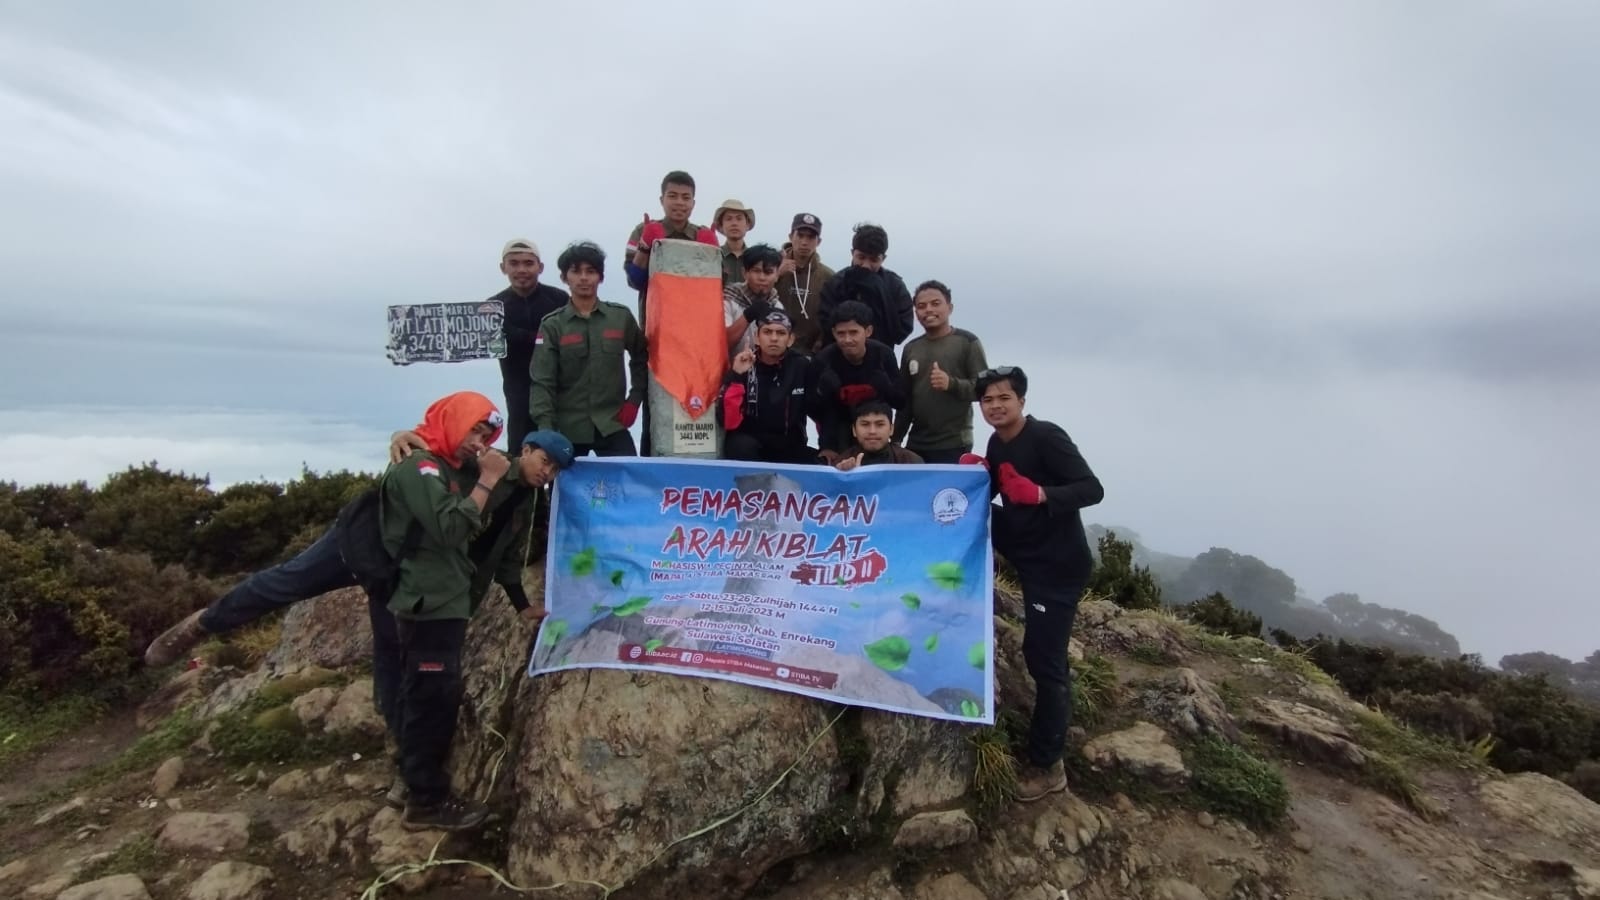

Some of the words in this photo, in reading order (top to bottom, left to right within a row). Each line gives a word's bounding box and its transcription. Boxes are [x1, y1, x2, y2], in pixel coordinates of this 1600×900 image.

[446, 304, 475, 315] MARIO
[415, 315, 500, 334] LATIMOJONG
[409, 333, 443, 352] 3478
[449, 332, 485, 350] MDPL
[675, 423, 694, 431] RANTE
[696, 423, 714, 431] MARIO
[680, 432, 693, 440] 3443
[695, 432, 710, 440] MDPL
[661, 487, 878, 526] PEMASANGAN
[662, 525, 753, 560] ARAH
[755, 530, 869, 561] KIBLAT
[756, 560, 784, 571] ALAM
[861, 559, 872, 578] II
[701, 603, 724, 612] 12-15
[727, 604, 746, 615] Juli
[747, 607, 773, 617] 2023
[775, 611, 785, 619] M
[722, 593, 750, 602] 23-26
[753, 596, 796, 610] Zulhijah
[799, 602, 826, 613] 1444
[828, 606, 838, 614] H
[686, 619, 751, 633] Latimojong,
[754, 626, 777, 638] Kab.
[781, 631, 836, 649] Enrekang
[687, 629, 735, 642] Sulawesi
[737, 635, 781, 651] Selatan
